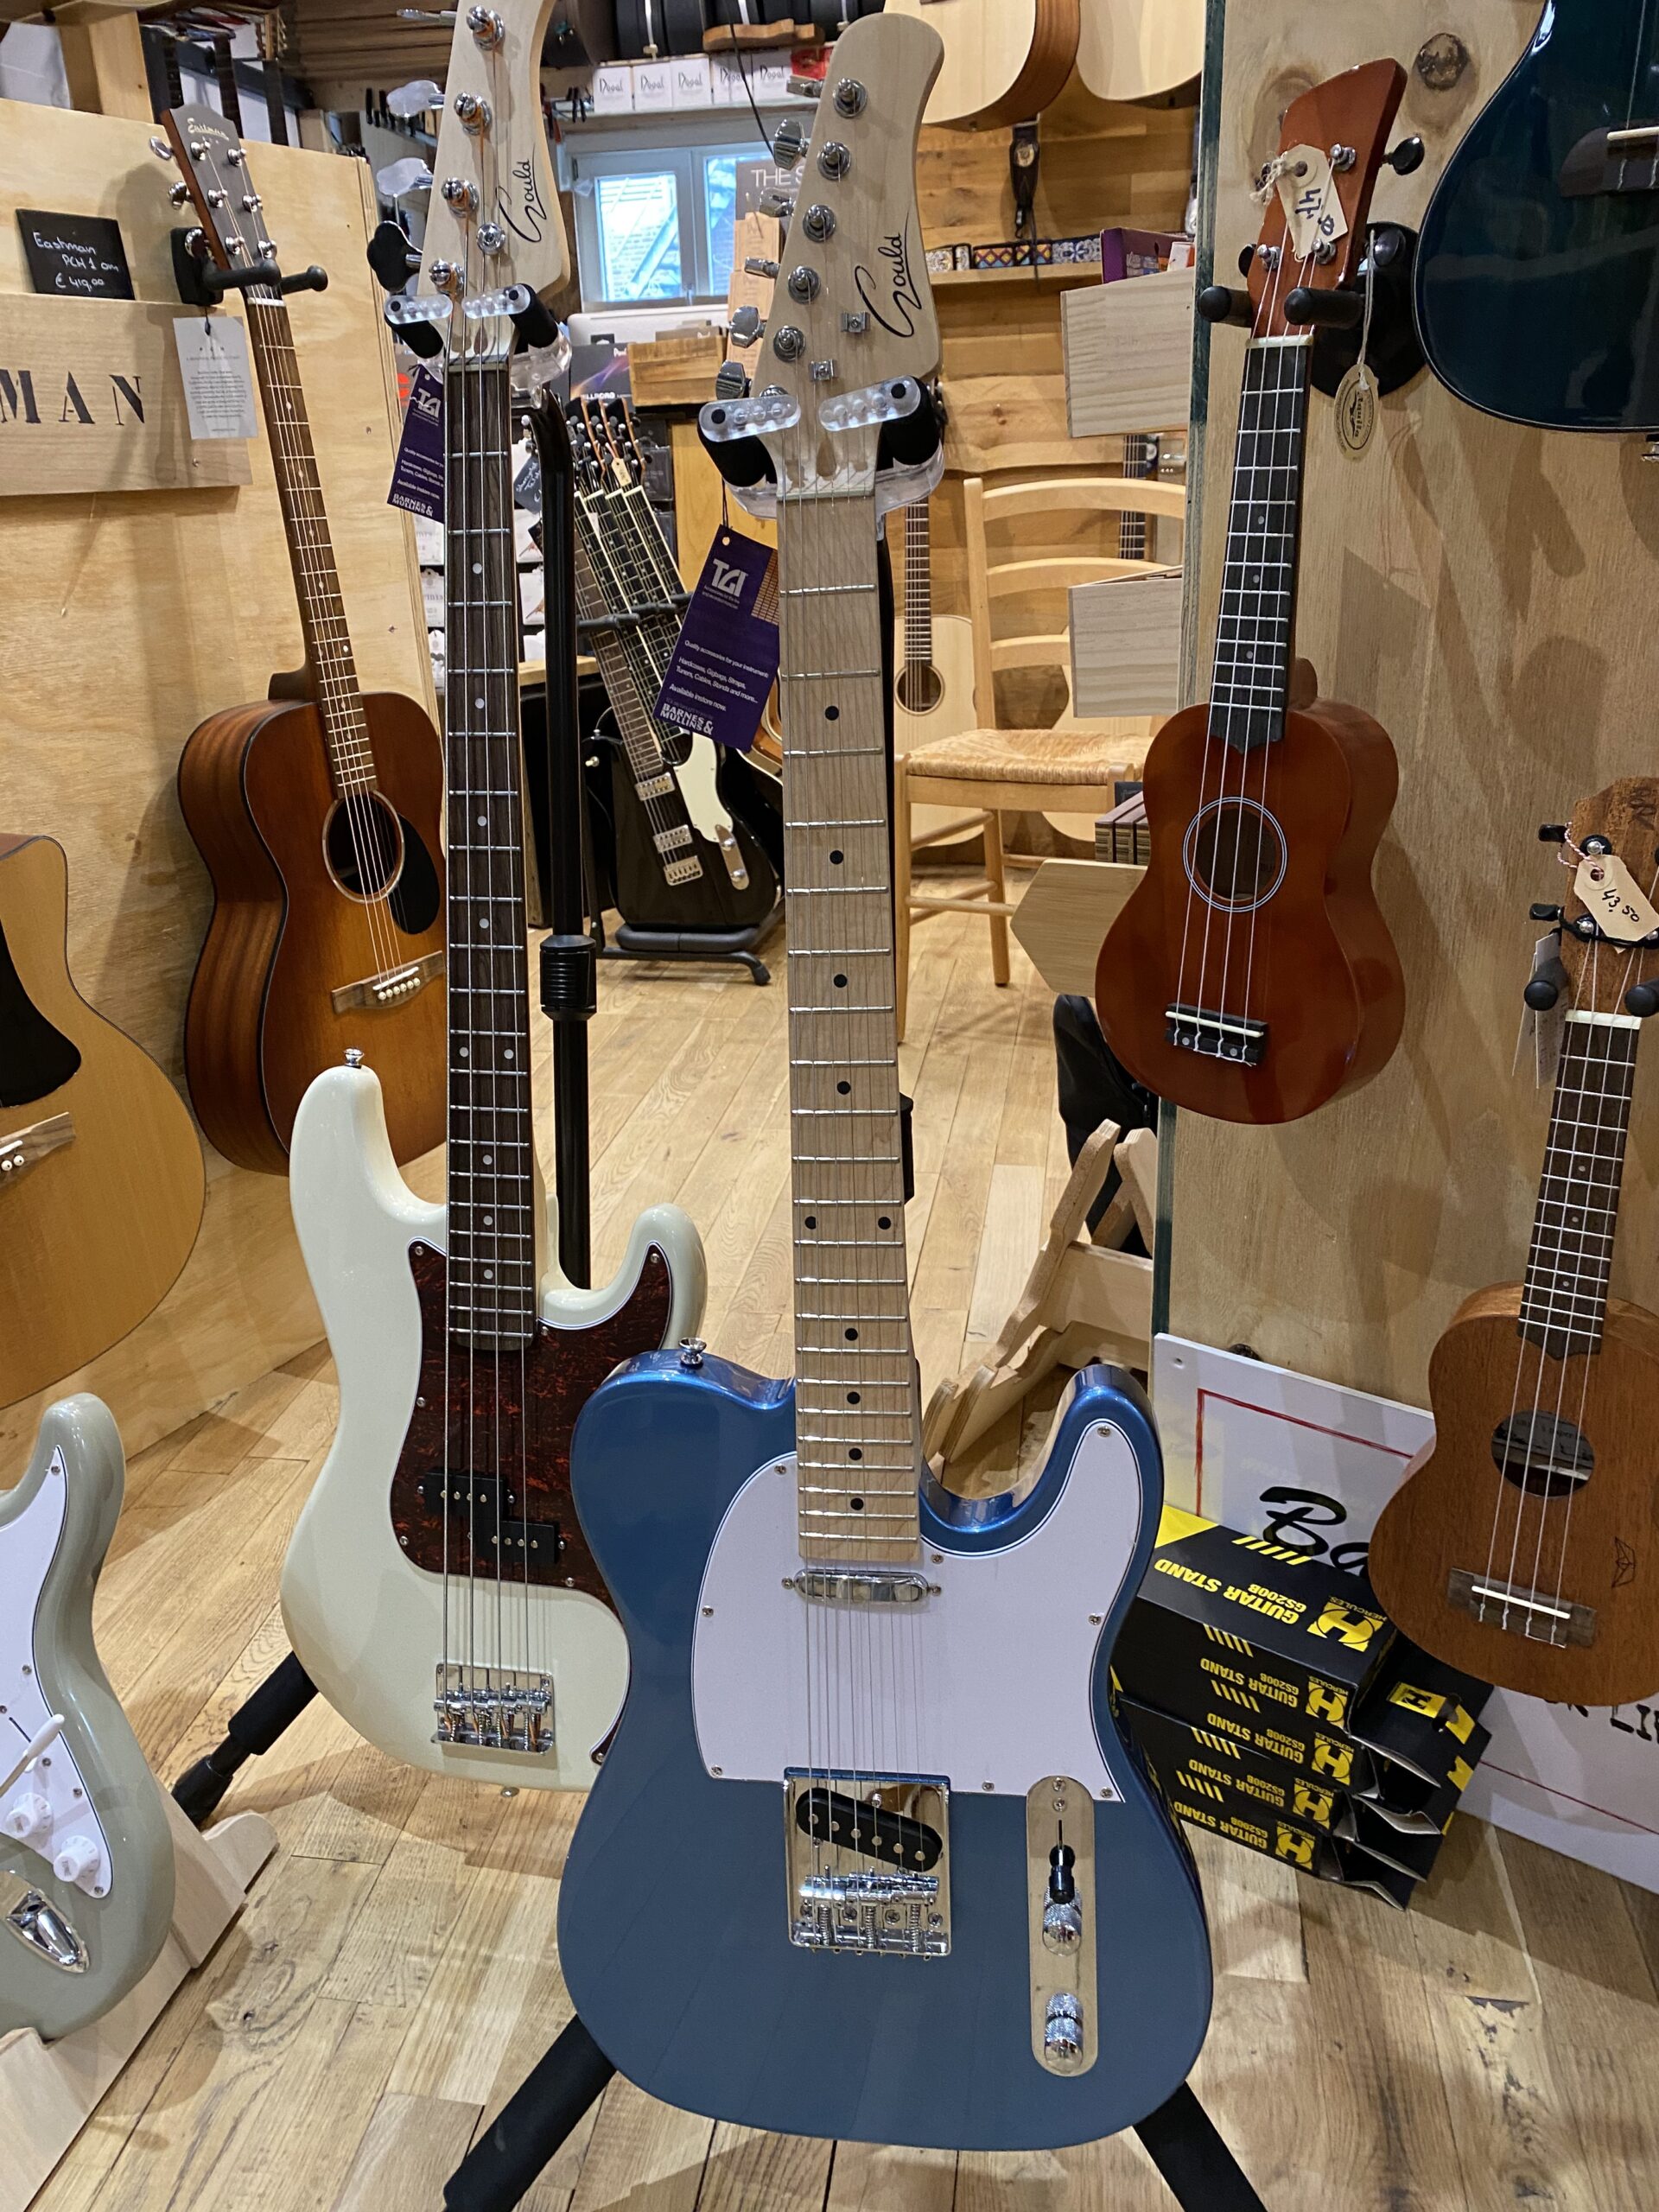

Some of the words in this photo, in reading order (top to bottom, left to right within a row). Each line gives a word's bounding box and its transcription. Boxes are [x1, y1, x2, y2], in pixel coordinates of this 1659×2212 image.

[750, 168, 791, 188] THE
[33, 231, 97, 255] Eastman
[392, 493, 426, 508] BARNES
[425, 505, 434, 518] &
[684, 639, 700, 652] Quality
[669, 683, 695, 699] Available
[659, 709, 703, 732] MULLINS
[662, 702, 705, 726] BARNES
[702, 720, 715, 736] &
[1154, 1559, 1222, 1592] STAND
[1223, 1586, 1300, 1624] GUITAR
[1247, 1584, 1307, 1613] GS200B
[1328, 1596, 1388, 1622] HERCULES
[1200, 1657, 1245, 1685] STAND
[1259, 1672, 1300, 1695] GS200B
[1248, 1677, 1298, 1708] GUITAR
[1207, 1713, 1251, 1741] STAND
[1266, 1729, 1306, 1751] GS200B
[1255, 1732, 1304, 1764] GUITAR
[1188, 1759, 1232, 1786] STAND
[1246, 1774, 1286, 1796] GS200B
[1236, 1778, 1285, 1808] GUITAR
[1173, 1801, 1216, 1827] STAND
[1219, 1820, 1268, 1850] GUITAR
[1230, 1816, 1268, 1839] GS200B
